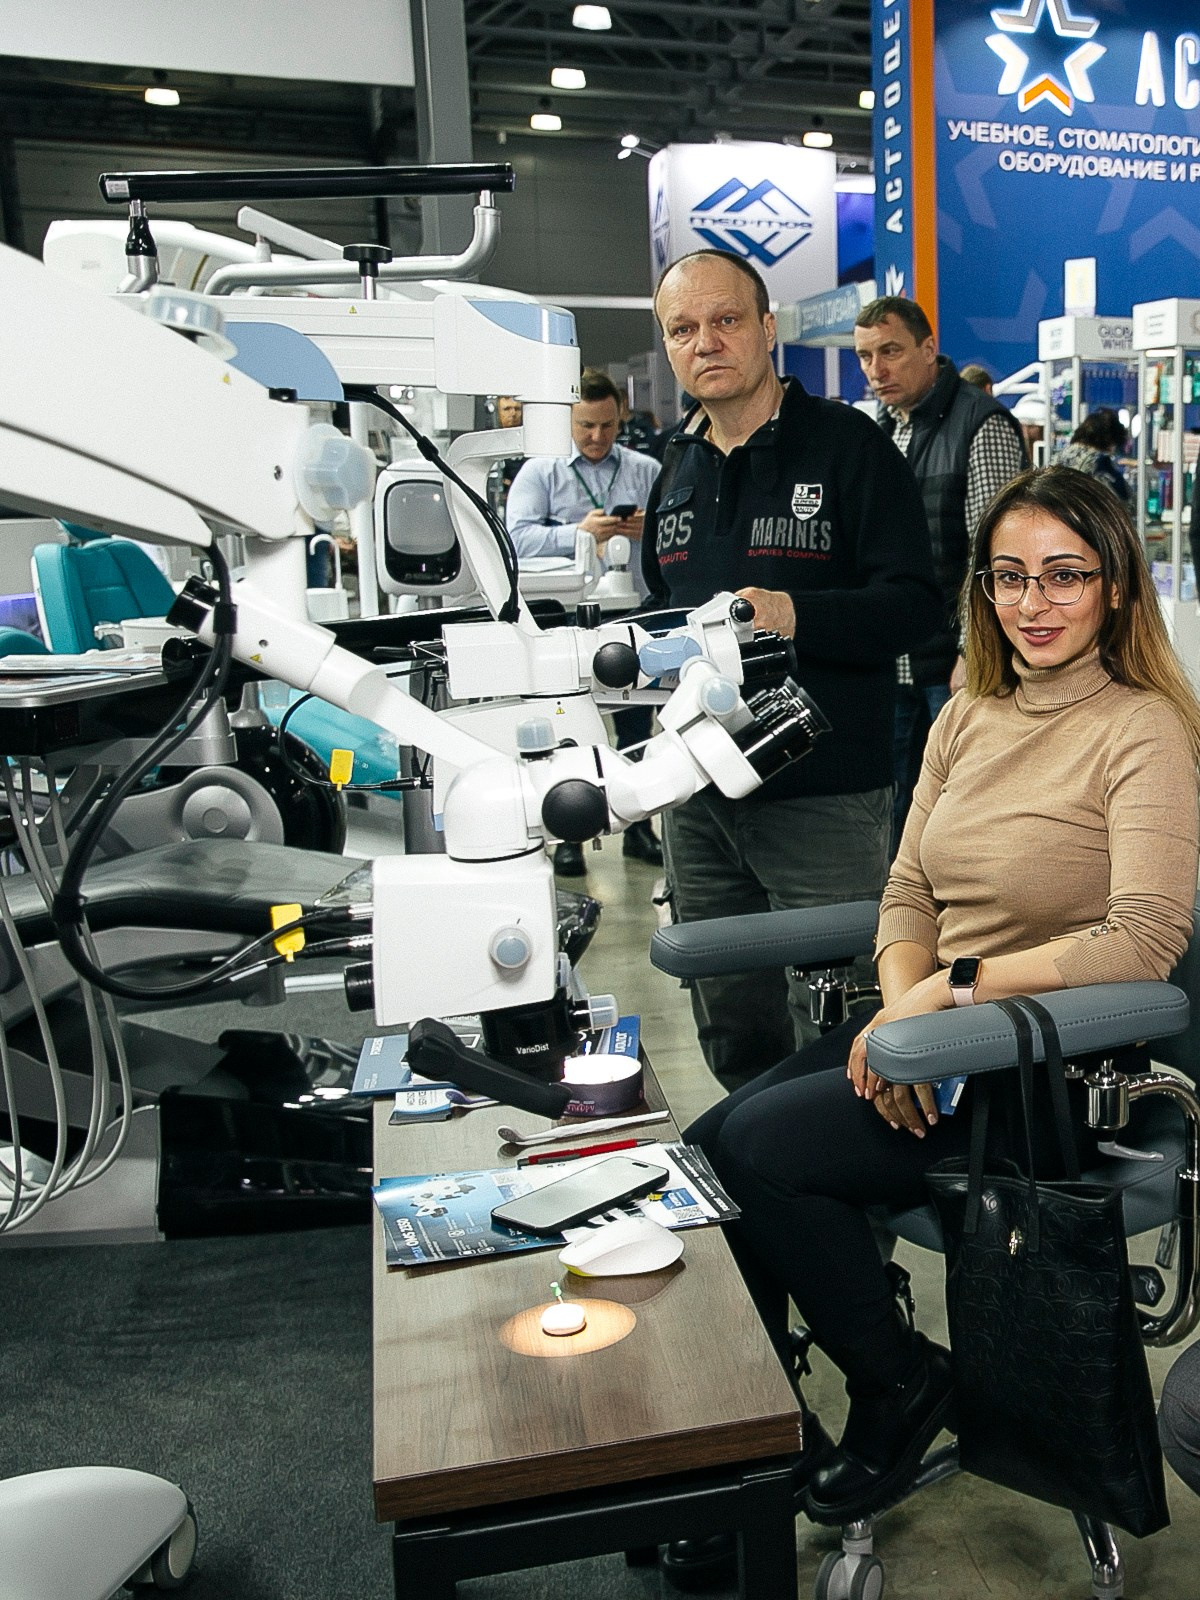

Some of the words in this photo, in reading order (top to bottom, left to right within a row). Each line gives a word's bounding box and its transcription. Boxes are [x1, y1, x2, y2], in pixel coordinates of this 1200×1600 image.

[948, 120, 1054, 149] УЧЕБНОЕ,
[999, 150, 1166, 182] ОБОРУДОВАНИЕ
[1171, 162, 1186, 182] И
[655, 511, 694, 555] 695
[750, 517, 832, 551] MARINES
[786, 550, 832, 560] COMPANY
[516, 1043, 549, 1055] VarioDist
